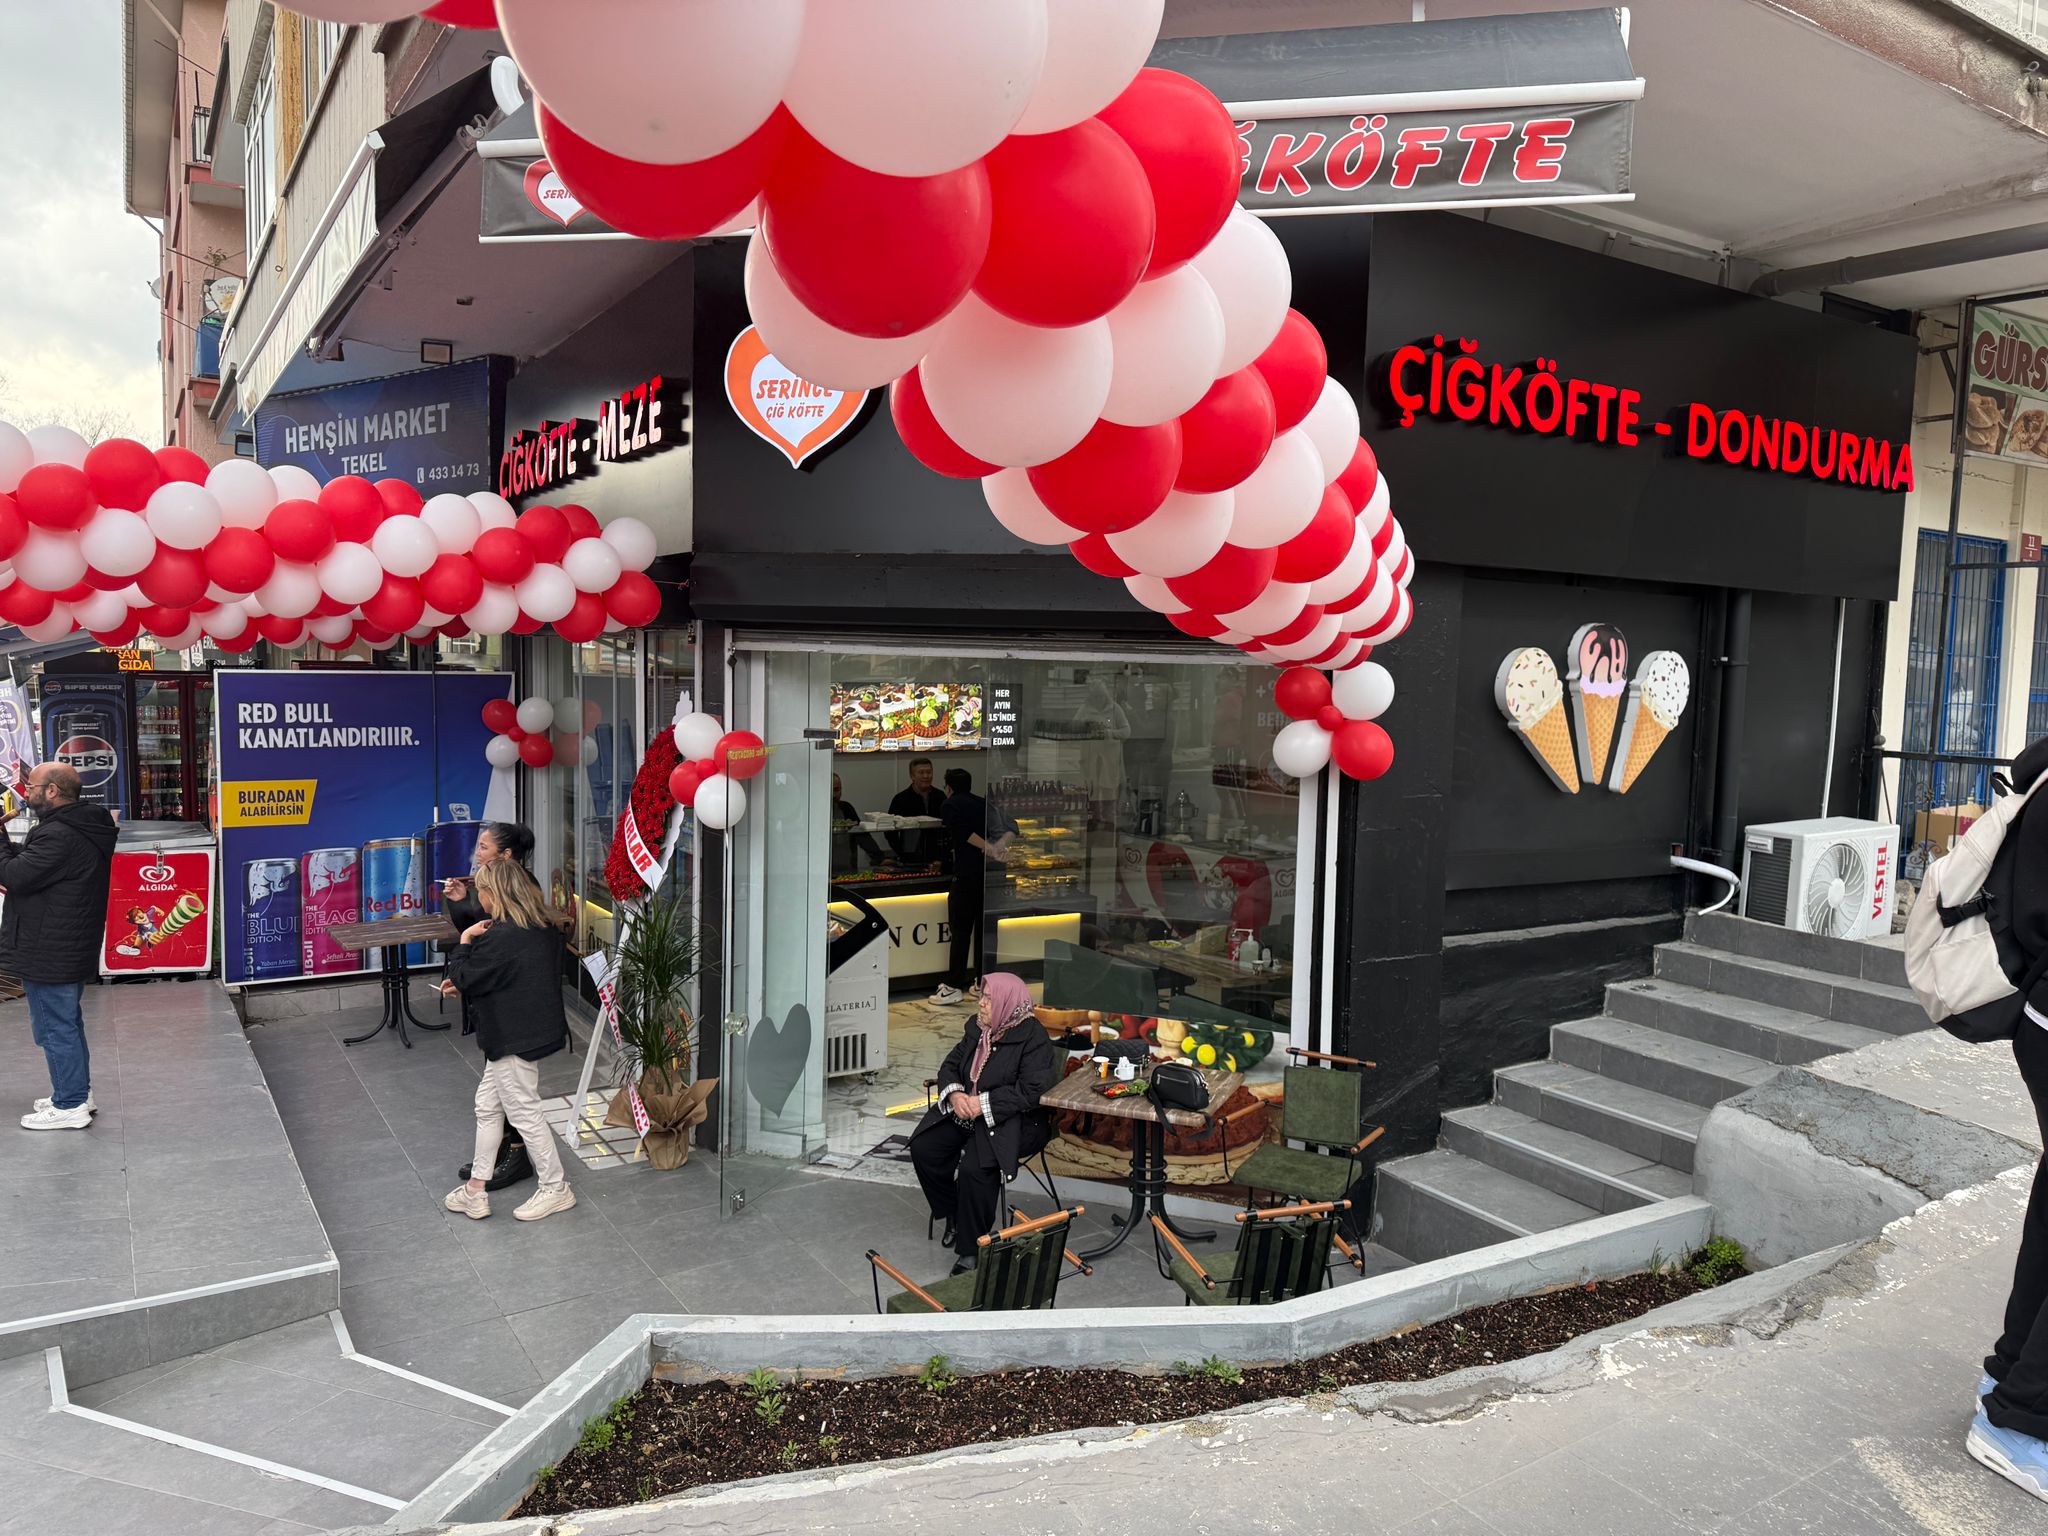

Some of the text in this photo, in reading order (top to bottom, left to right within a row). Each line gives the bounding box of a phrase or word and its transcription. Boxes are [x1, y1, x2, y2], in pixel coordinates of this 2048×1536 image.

[597, 374, 662, 462] MEZE
[766, 402, 825, 421] ÇİĞ KÖFTE
[1389, 333, 1642, 447] ÇİĞKÖFTE
[1686, 402, 1915, 492] DONDURMA
[285, 402, 450, 455] HEMŞİN MARKET
[341, 452, 388, 475] TEKEL
[428, 462, 480, 481] 433 14 73
[995, 689, 1010, 698] HER
[238, 702, 333, 724] RED BULL
[993, 701, 1011, 710] AYIN
[992, 737, 1016, 746] EDAVA
[58, 755, 114, 767] PEPSI
[238, 789, 306, 805] BURADAN
[240, 803, 304, 817] ALABİLİRSİN
[138, 883, 175, 892] ALGIDA
[1871, 840, 1888, 920] VESTEL
[366, 893, 397, 913] Red
[247, 935, 282, 944] EDITION
